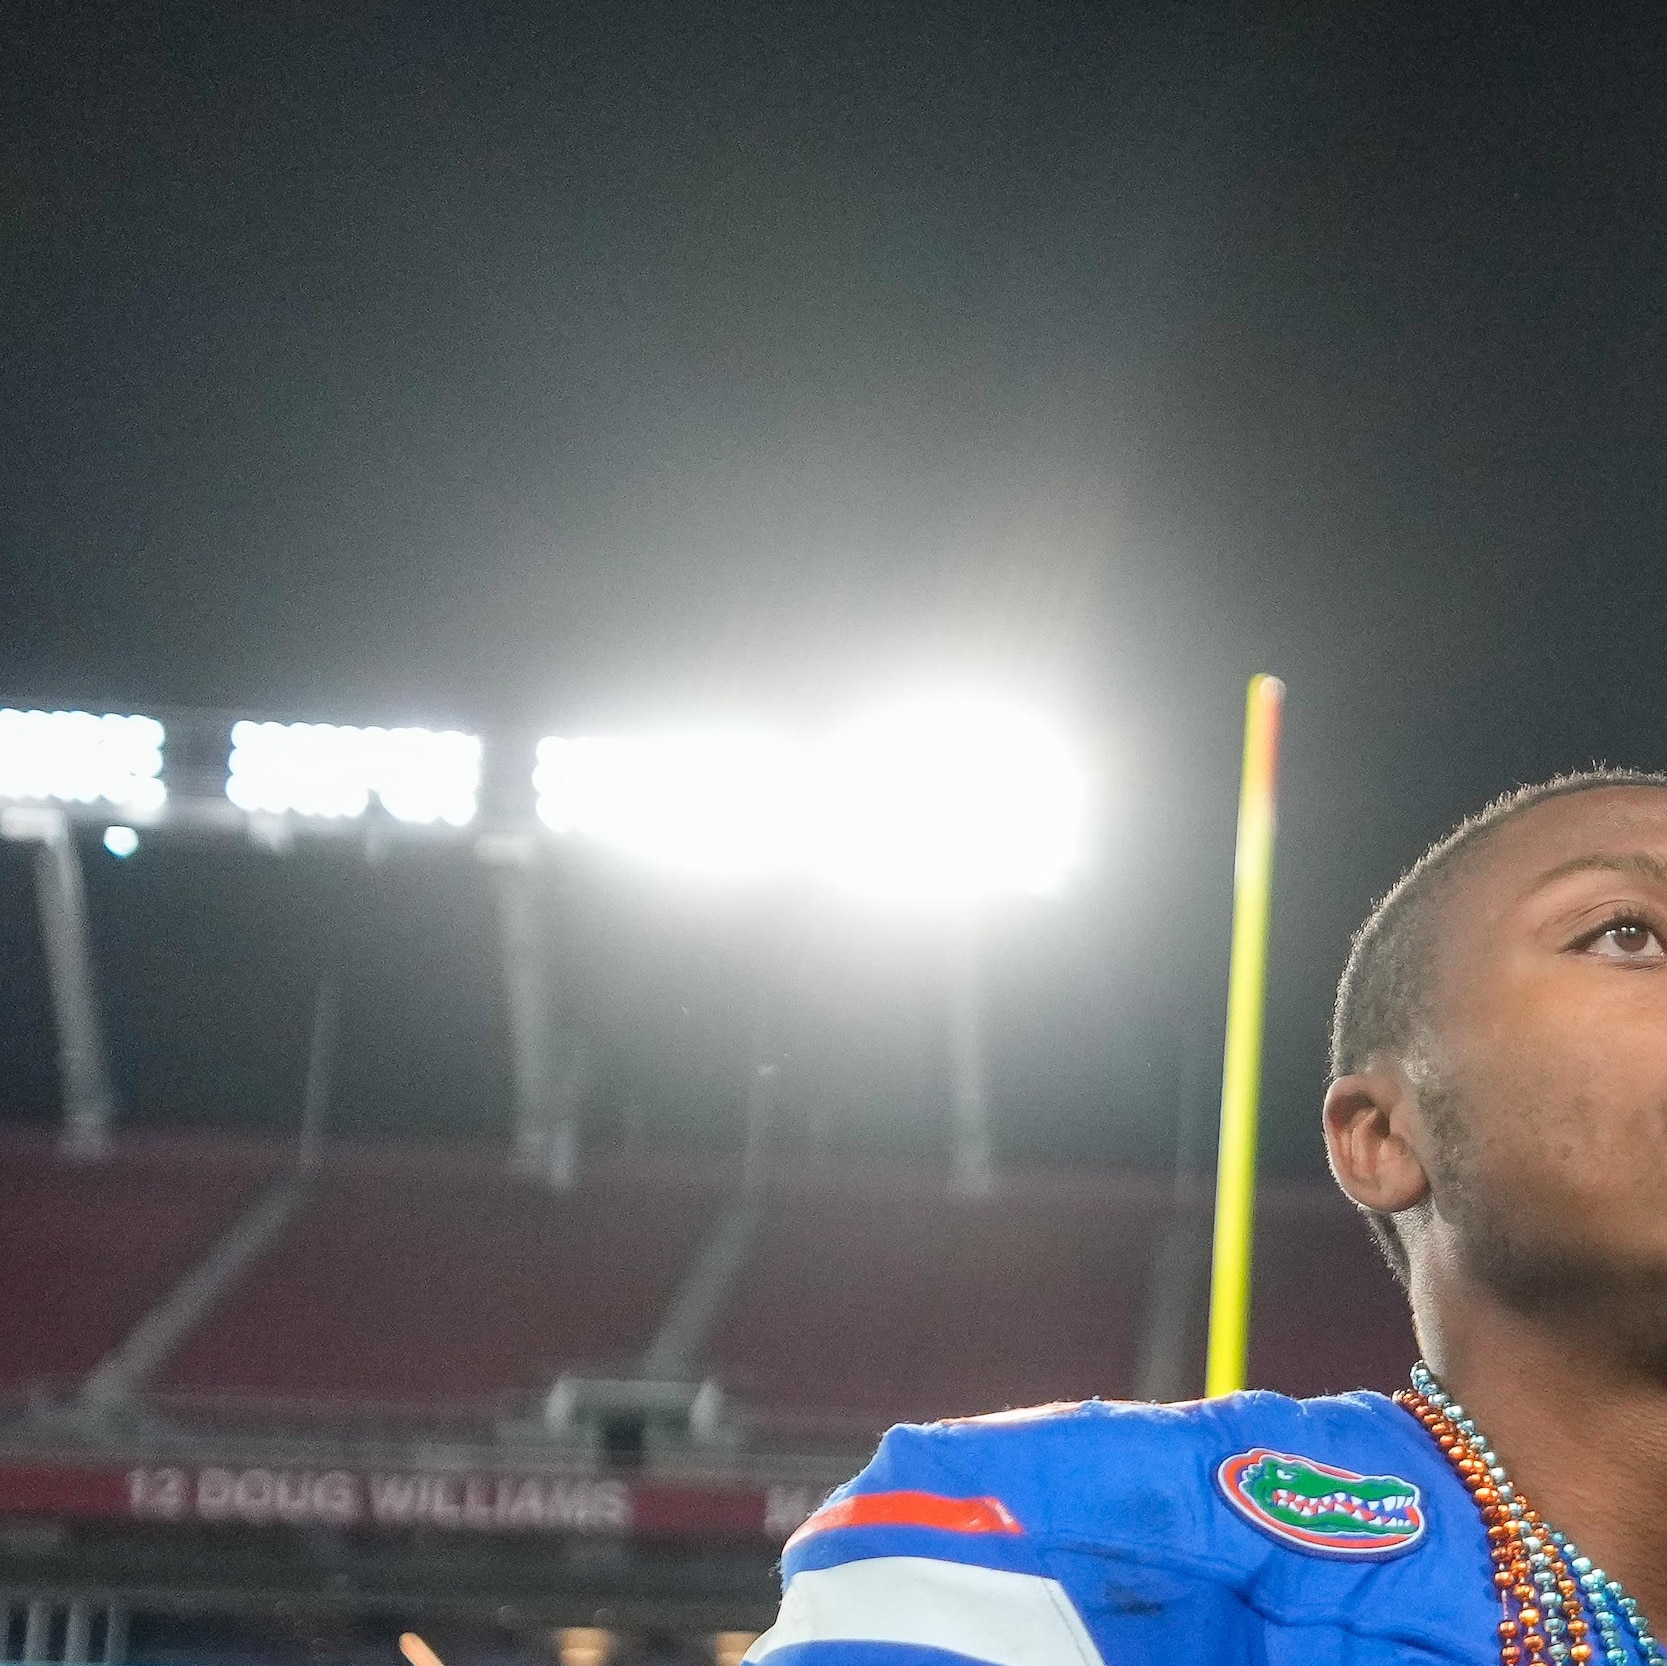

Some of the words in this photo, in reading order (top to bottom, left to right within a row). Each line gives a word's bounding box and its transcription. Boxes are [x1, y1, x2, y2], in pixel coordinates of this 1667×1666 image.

[128, 1467, 188, 1521] 12
[197, 1468, 358, 1524] DOUG
[371, 1472, 630, 1531] WILLIAMS
